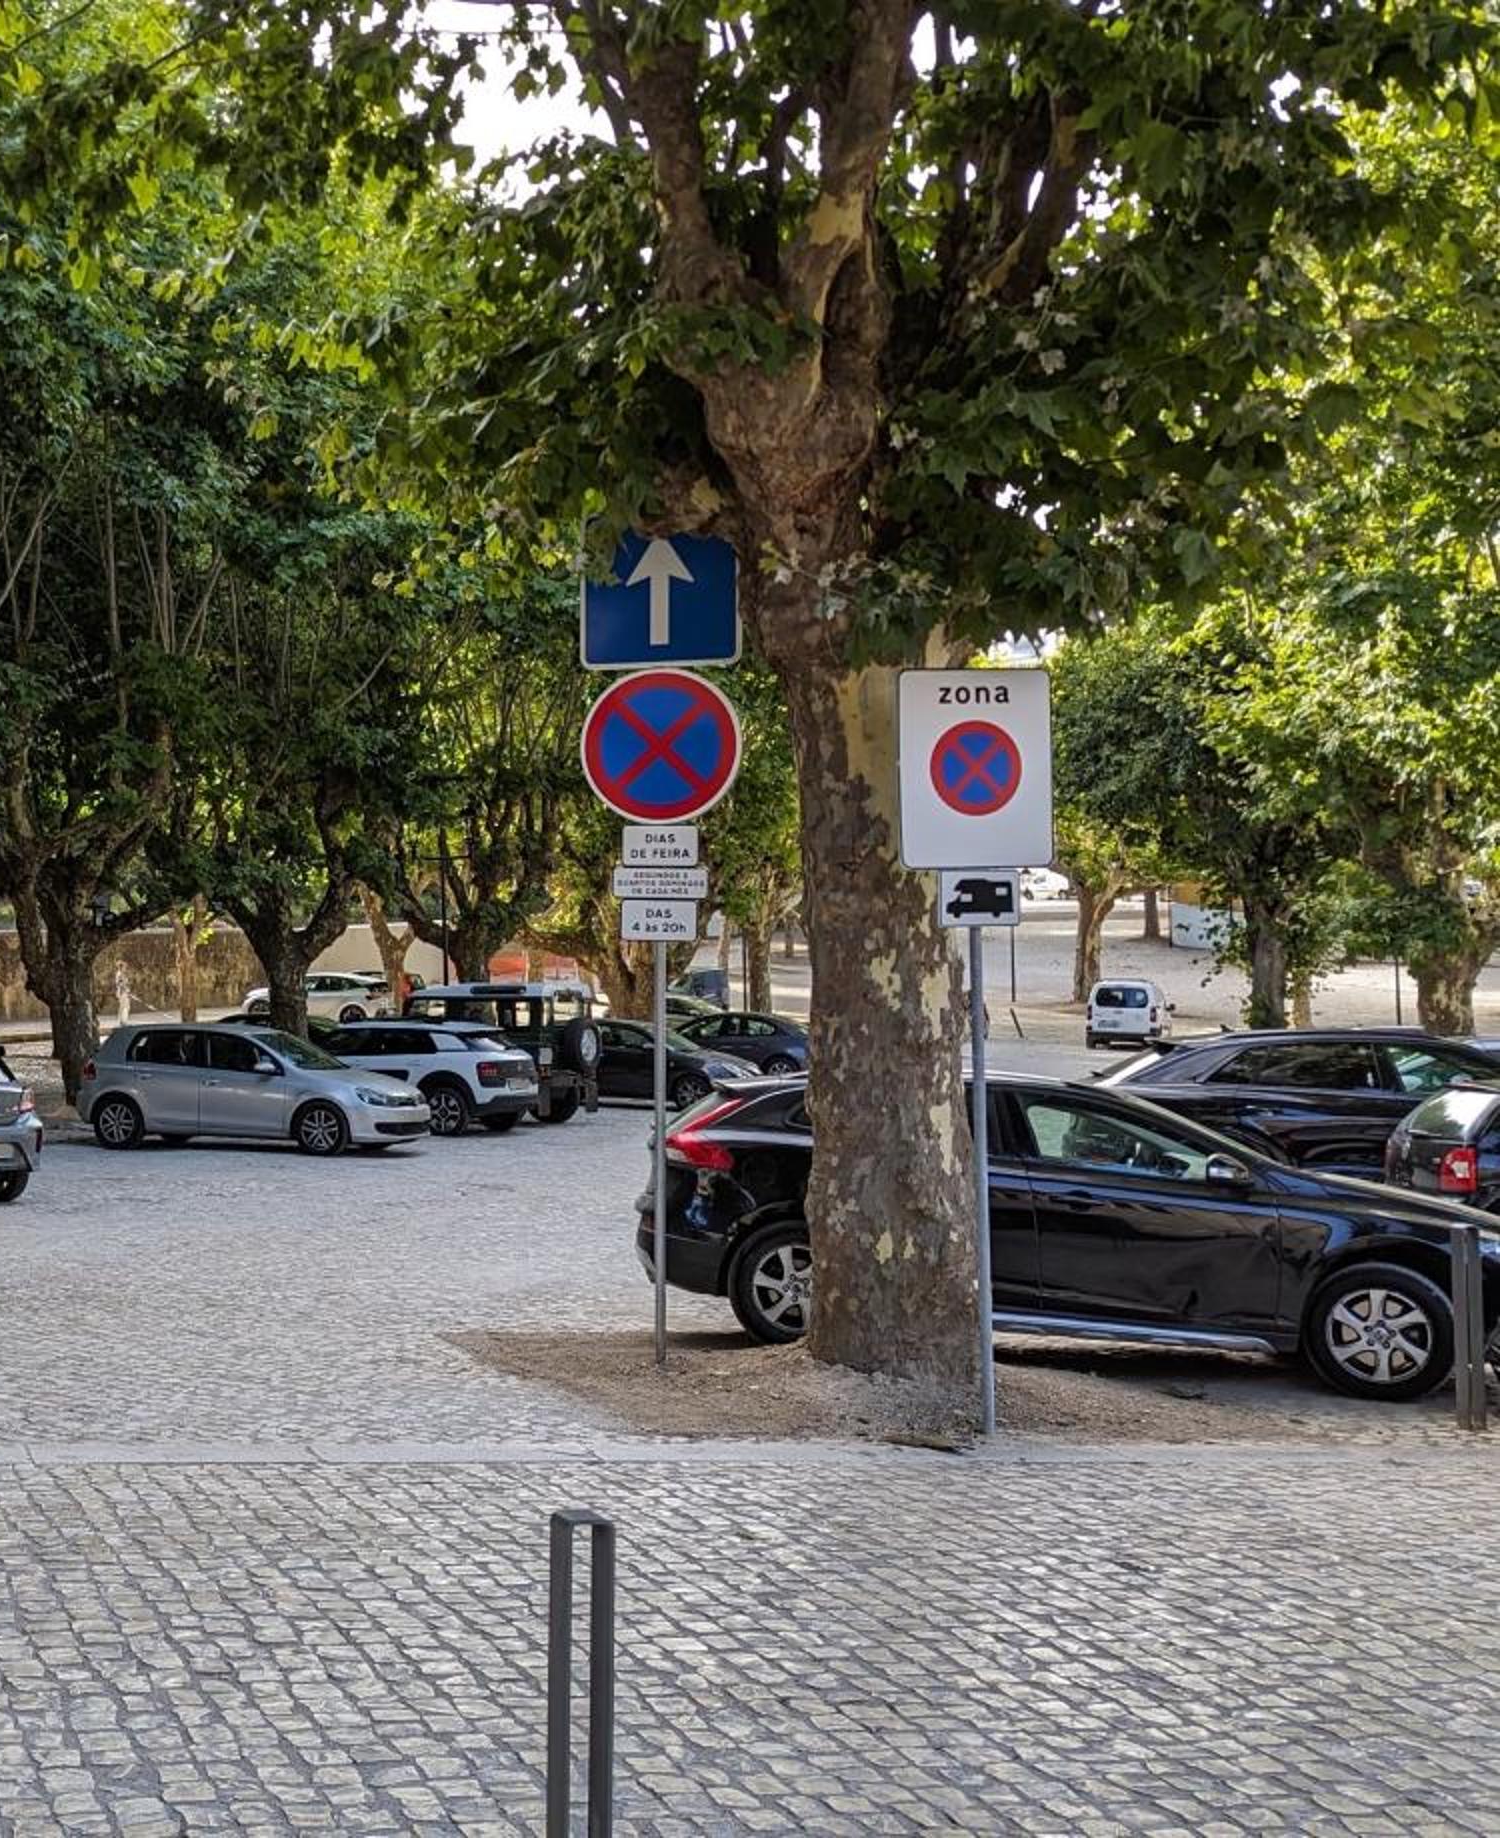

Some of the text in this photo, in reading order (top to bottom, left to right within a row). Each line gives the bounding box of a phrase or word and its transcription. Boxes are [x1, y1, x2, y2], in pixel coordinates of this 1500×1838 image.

[938, 685, 1010, 704] zona
[645, 833, 676, 844] DIAS
[630, 848, 690, 859] DE FEIRA
[645, 909, 673, 918] DAS
[632, 922, 687, 932] 4 às 20h
